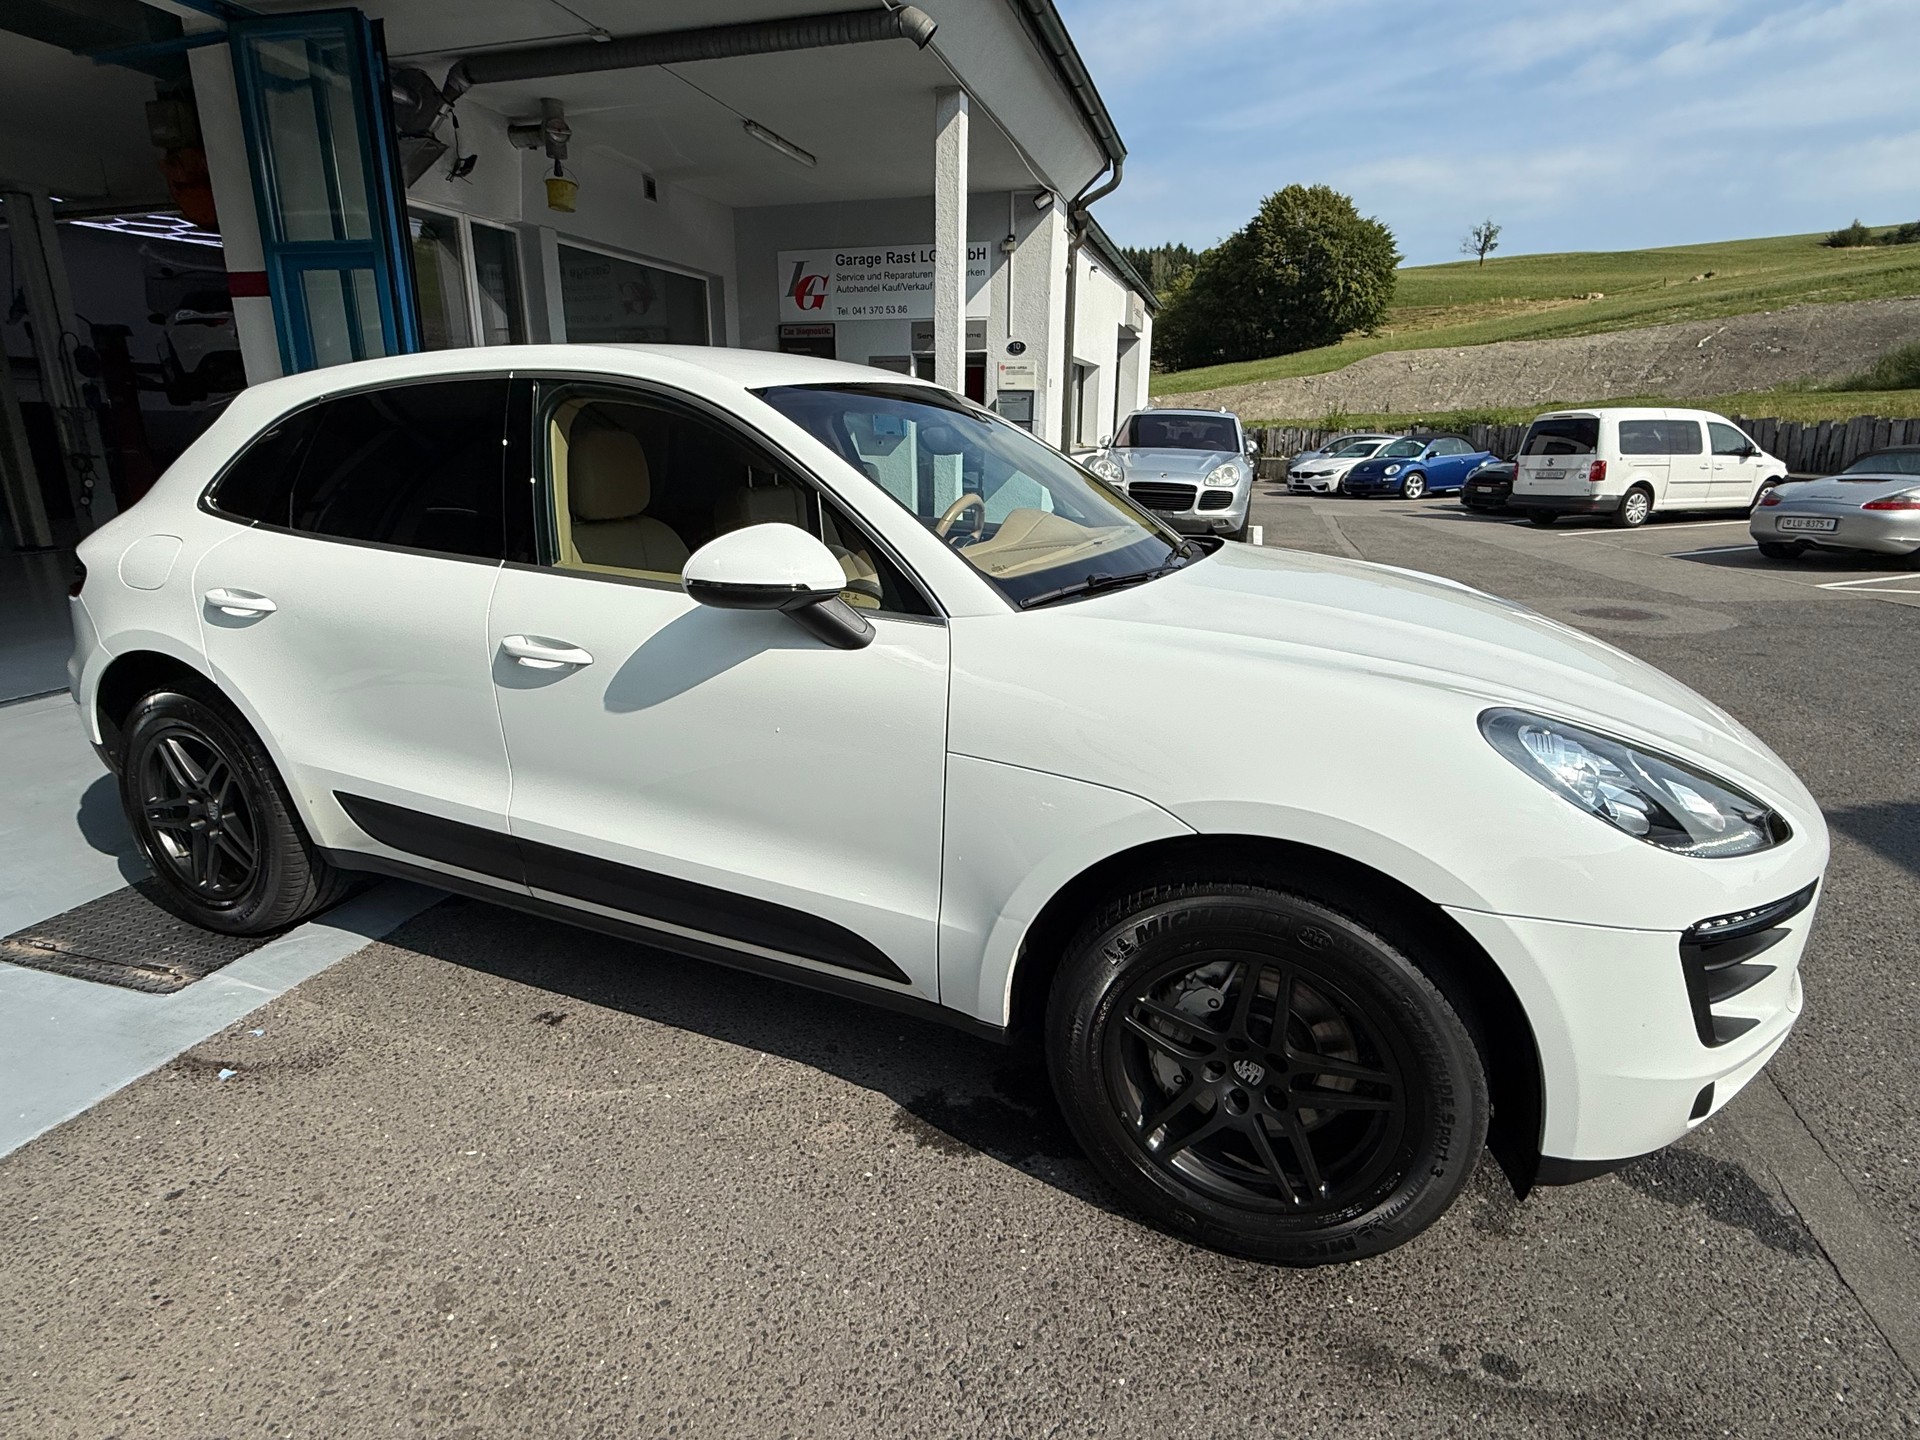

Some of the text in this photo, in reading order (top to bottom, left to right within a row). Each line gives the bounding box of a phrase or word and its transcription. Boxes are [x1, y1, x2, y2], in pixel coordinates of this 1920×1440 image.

[835, 254, 882, 268] Garage
[886, 251, 916, 264] Rast
[967, 247, 986, 260] bH
[836, 268, 986, 282] Service und Reparaturen rken
[836, 281, 933, 293] Autohandel Kauf/Verkauf
[852, 306, 866, 315] 041
[869, 306, 884, 314] 370
[885, 305, 896, 314] 53
[897, 305, 908, 314] 86
[796, 326, 831, 336] Diagnostic
[1013, 342, 1021, 350] 10
[1434, 1113, 1456, 1162] Sport
[1430, 1164, 1445, 1178] 3
